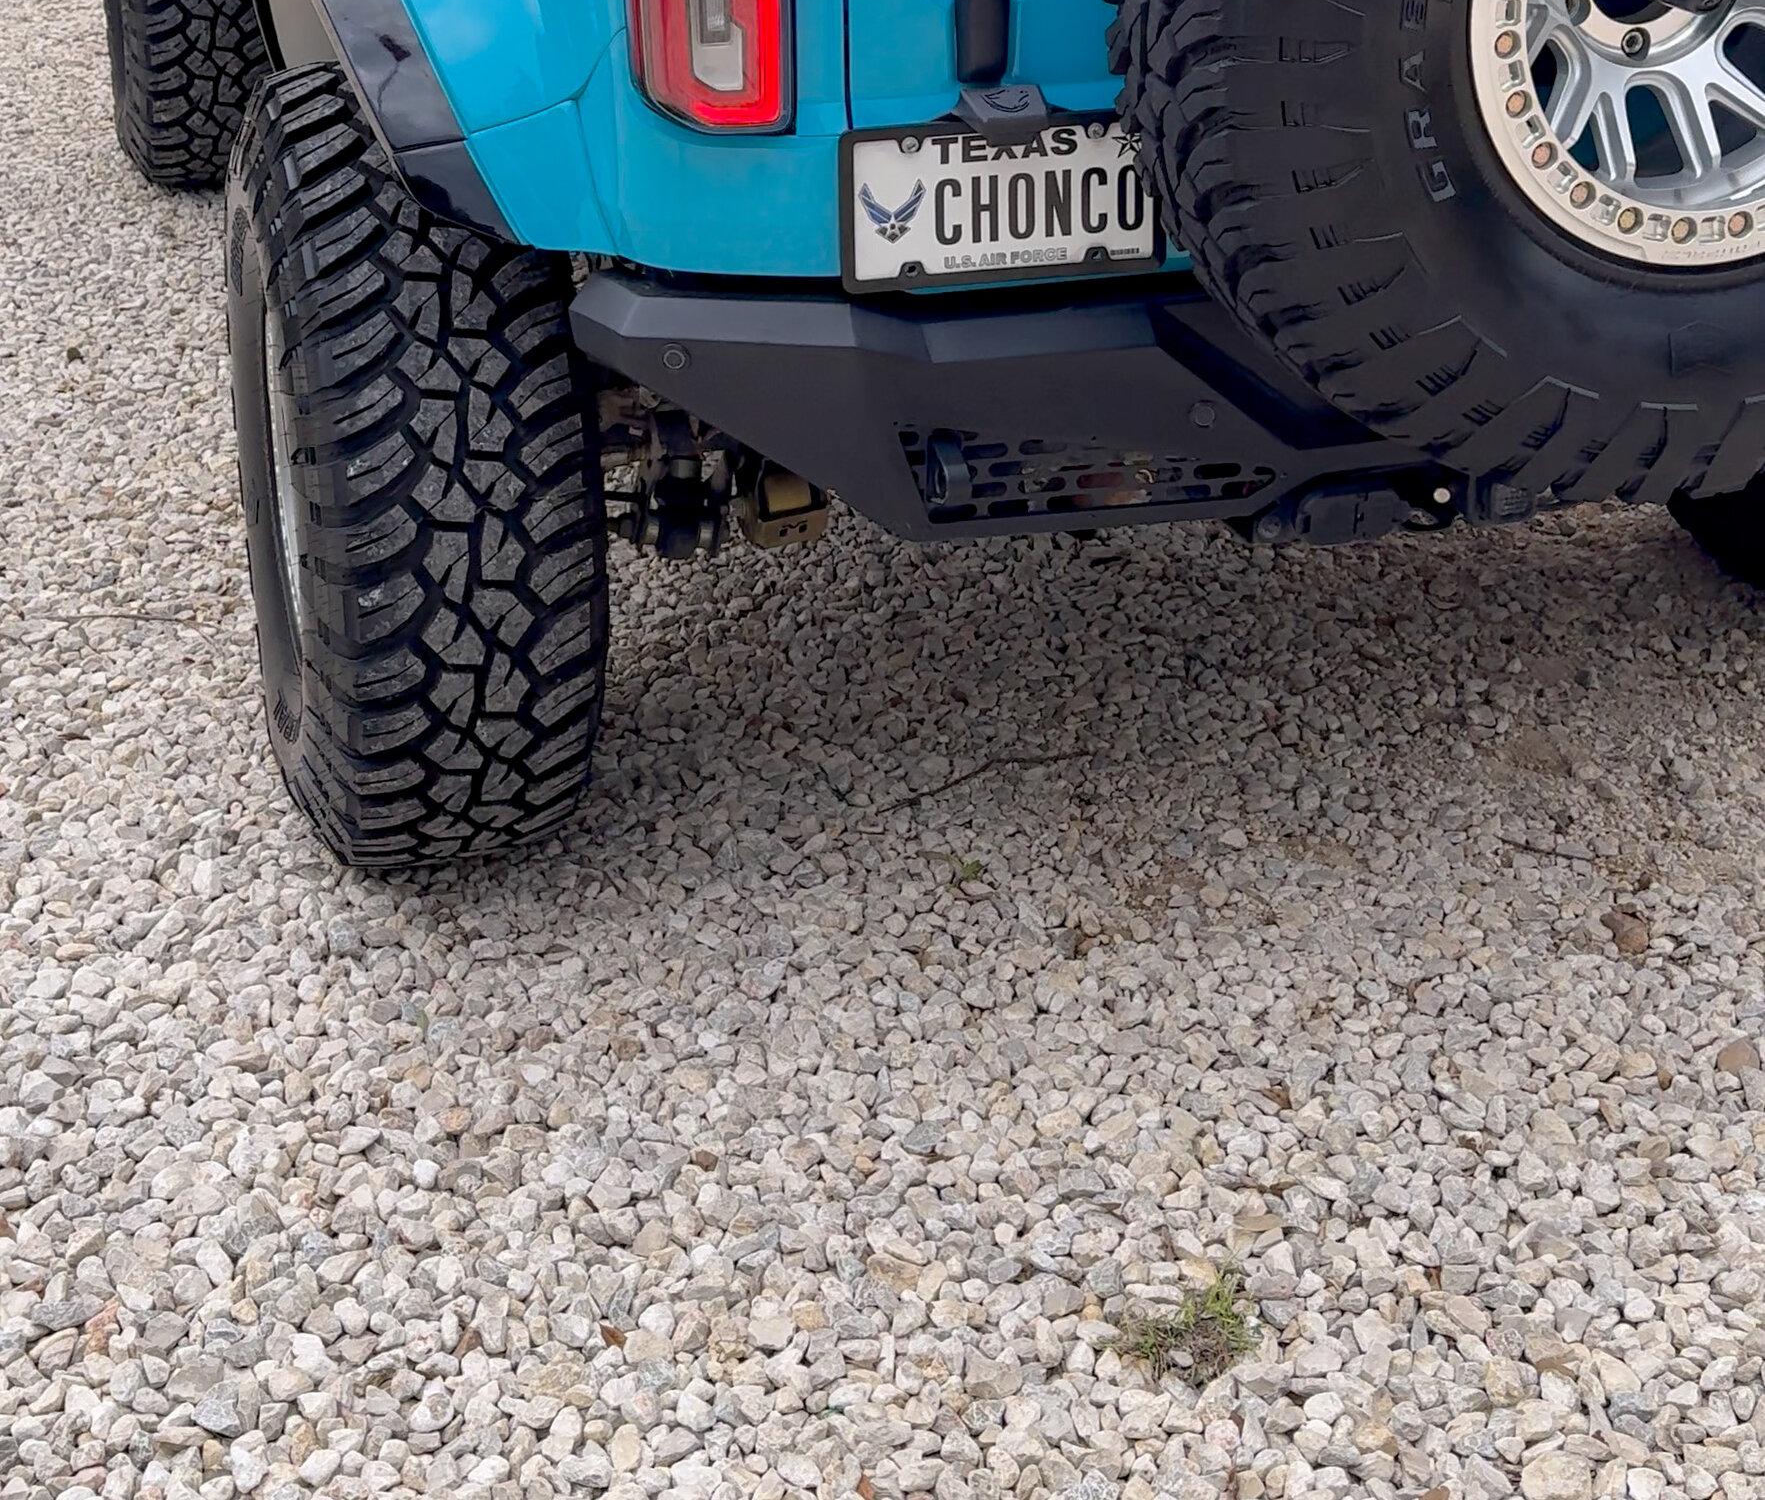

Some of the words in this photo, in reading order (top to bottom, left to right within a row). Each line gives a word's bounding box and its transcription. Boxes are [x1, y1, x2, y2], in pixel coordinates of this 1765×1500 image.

[932, 128, 1078, 165] TEXAS
[935, 165, 1144, 246] CHONCO
[944, 255, 976, 270] U.S.
[979, 252, 1008, 267] AIR
[1011, 247, 1068, 265] FORCE
